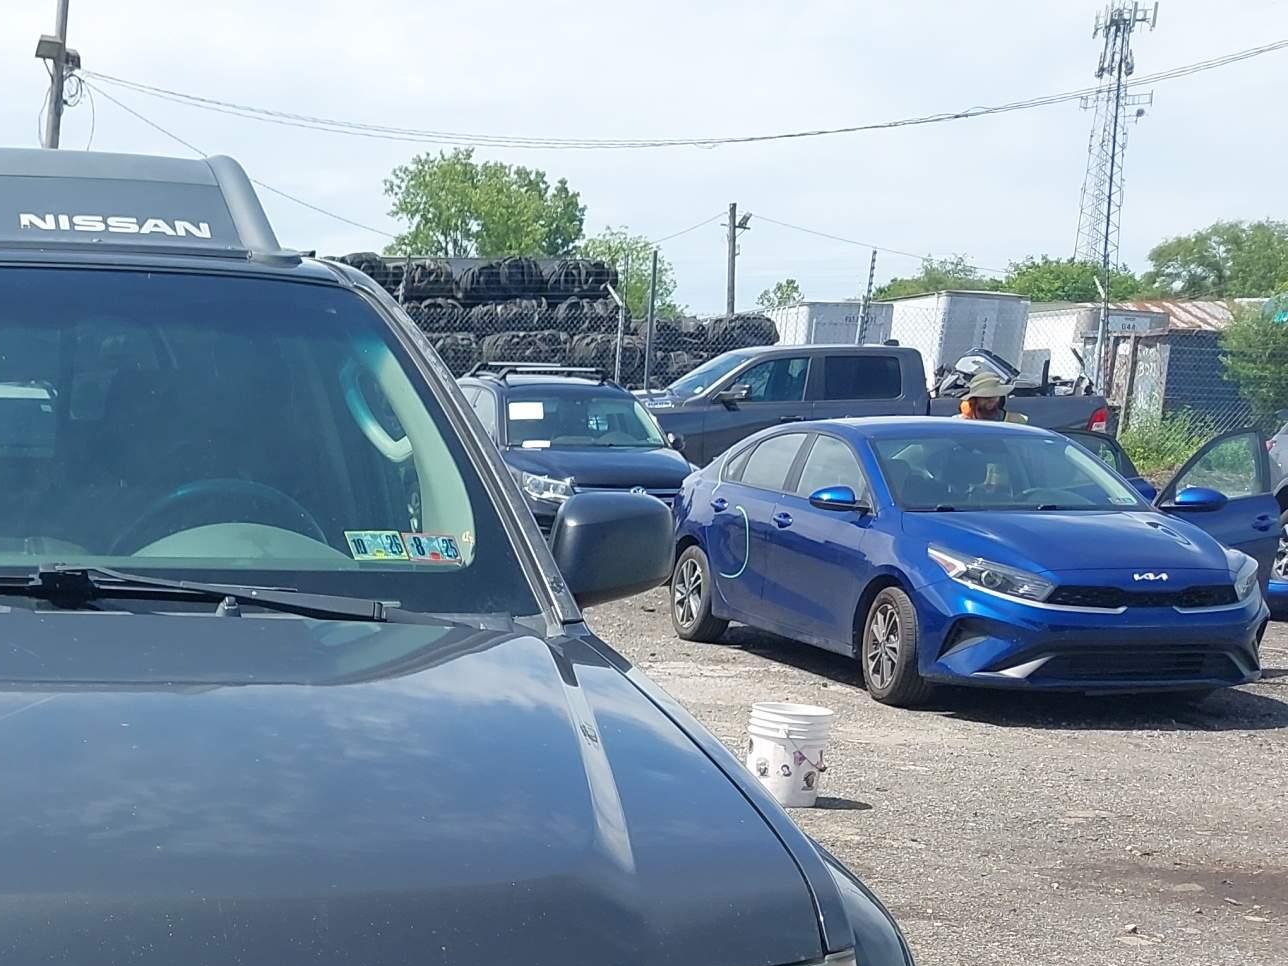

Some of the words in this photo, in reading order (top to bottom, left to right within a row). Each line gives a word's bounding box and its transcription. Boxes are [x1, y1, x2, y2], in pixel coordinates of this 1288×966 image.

[19, 213, 212, 239] NISSAN
[351, 537, 367, 555] 10
[385, 534, 404, 555] 26
[442, 538, 458, 558] 25
